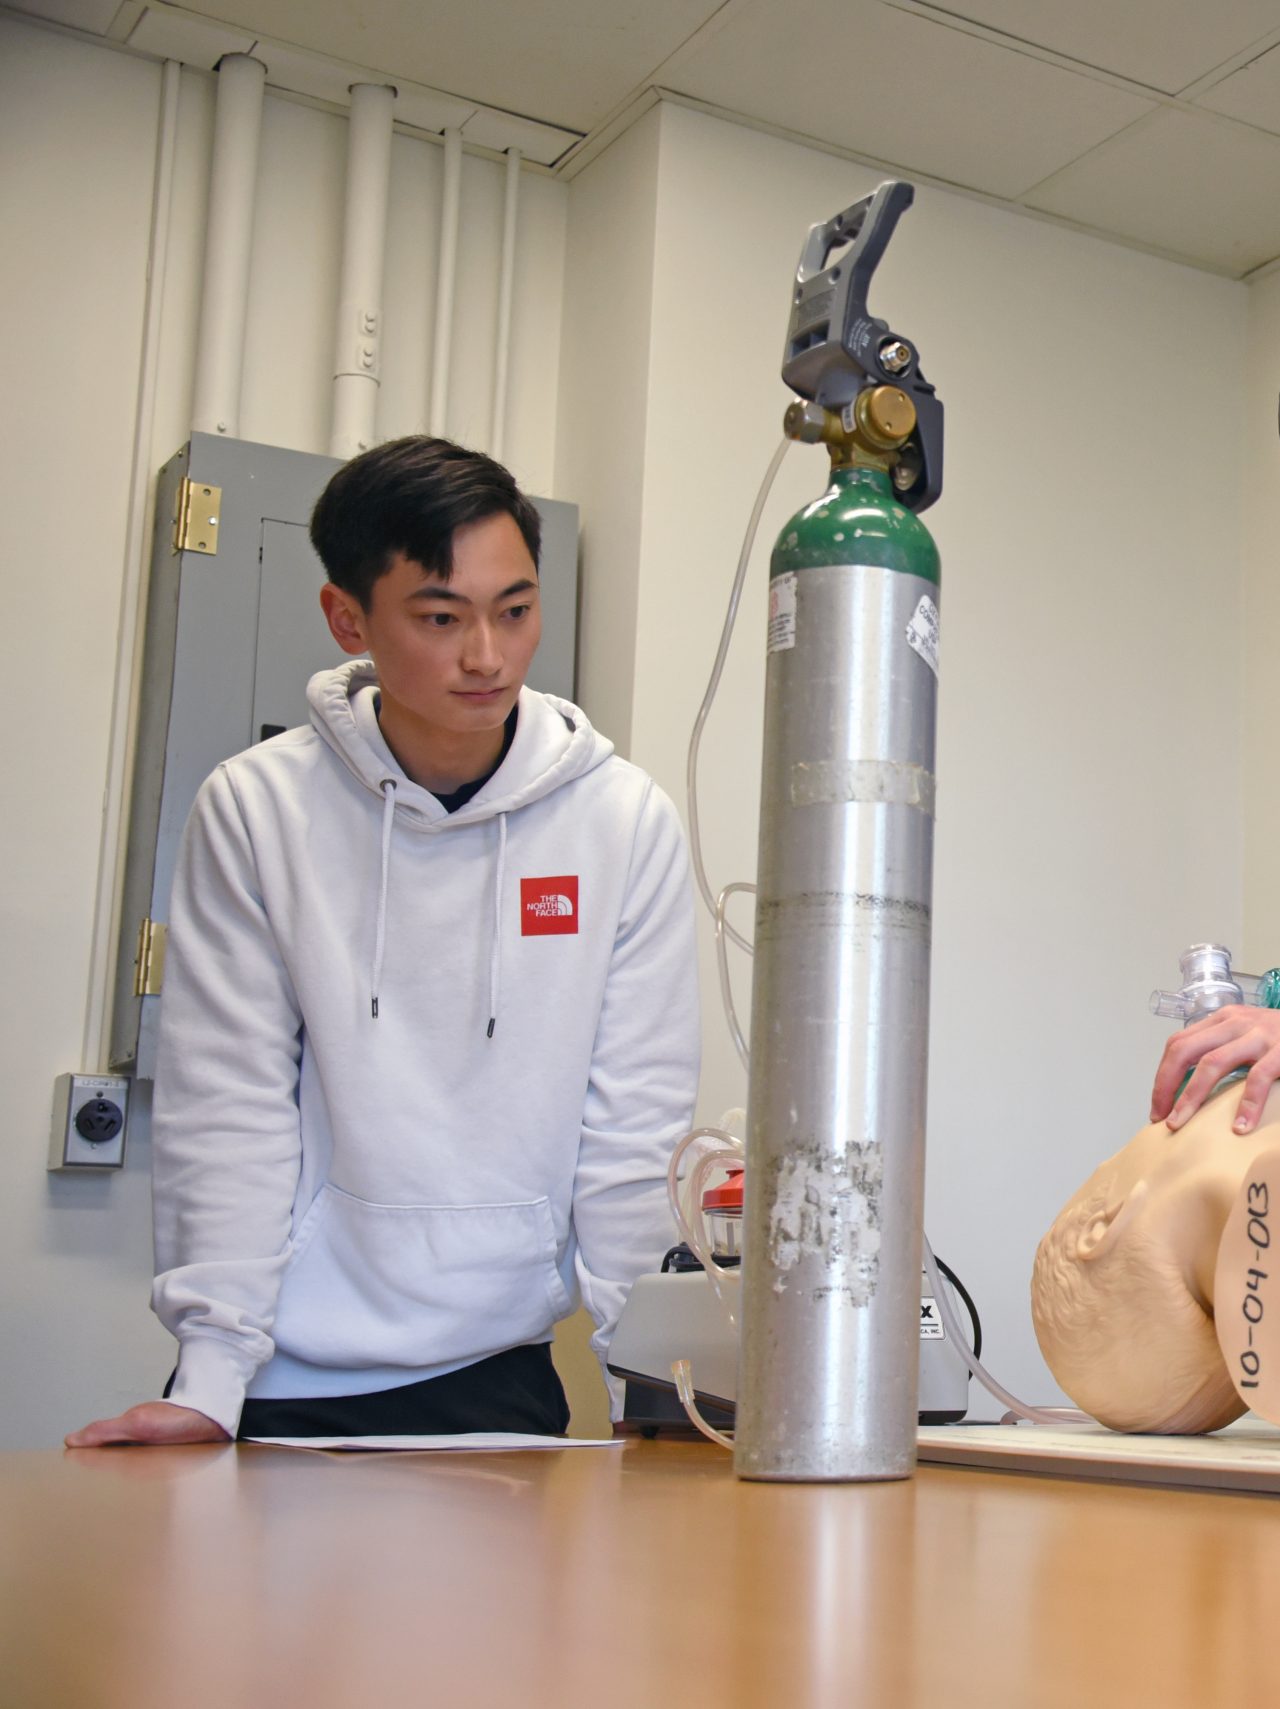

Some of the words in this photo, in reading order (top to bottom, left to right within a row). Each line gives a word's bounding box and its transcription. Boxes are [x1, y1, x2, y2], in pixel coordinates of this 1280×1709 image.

[540, 895, 558, 903] THE
[526, 902, 558, 911] NORTH
[535, 909, 558, 917] FACE
